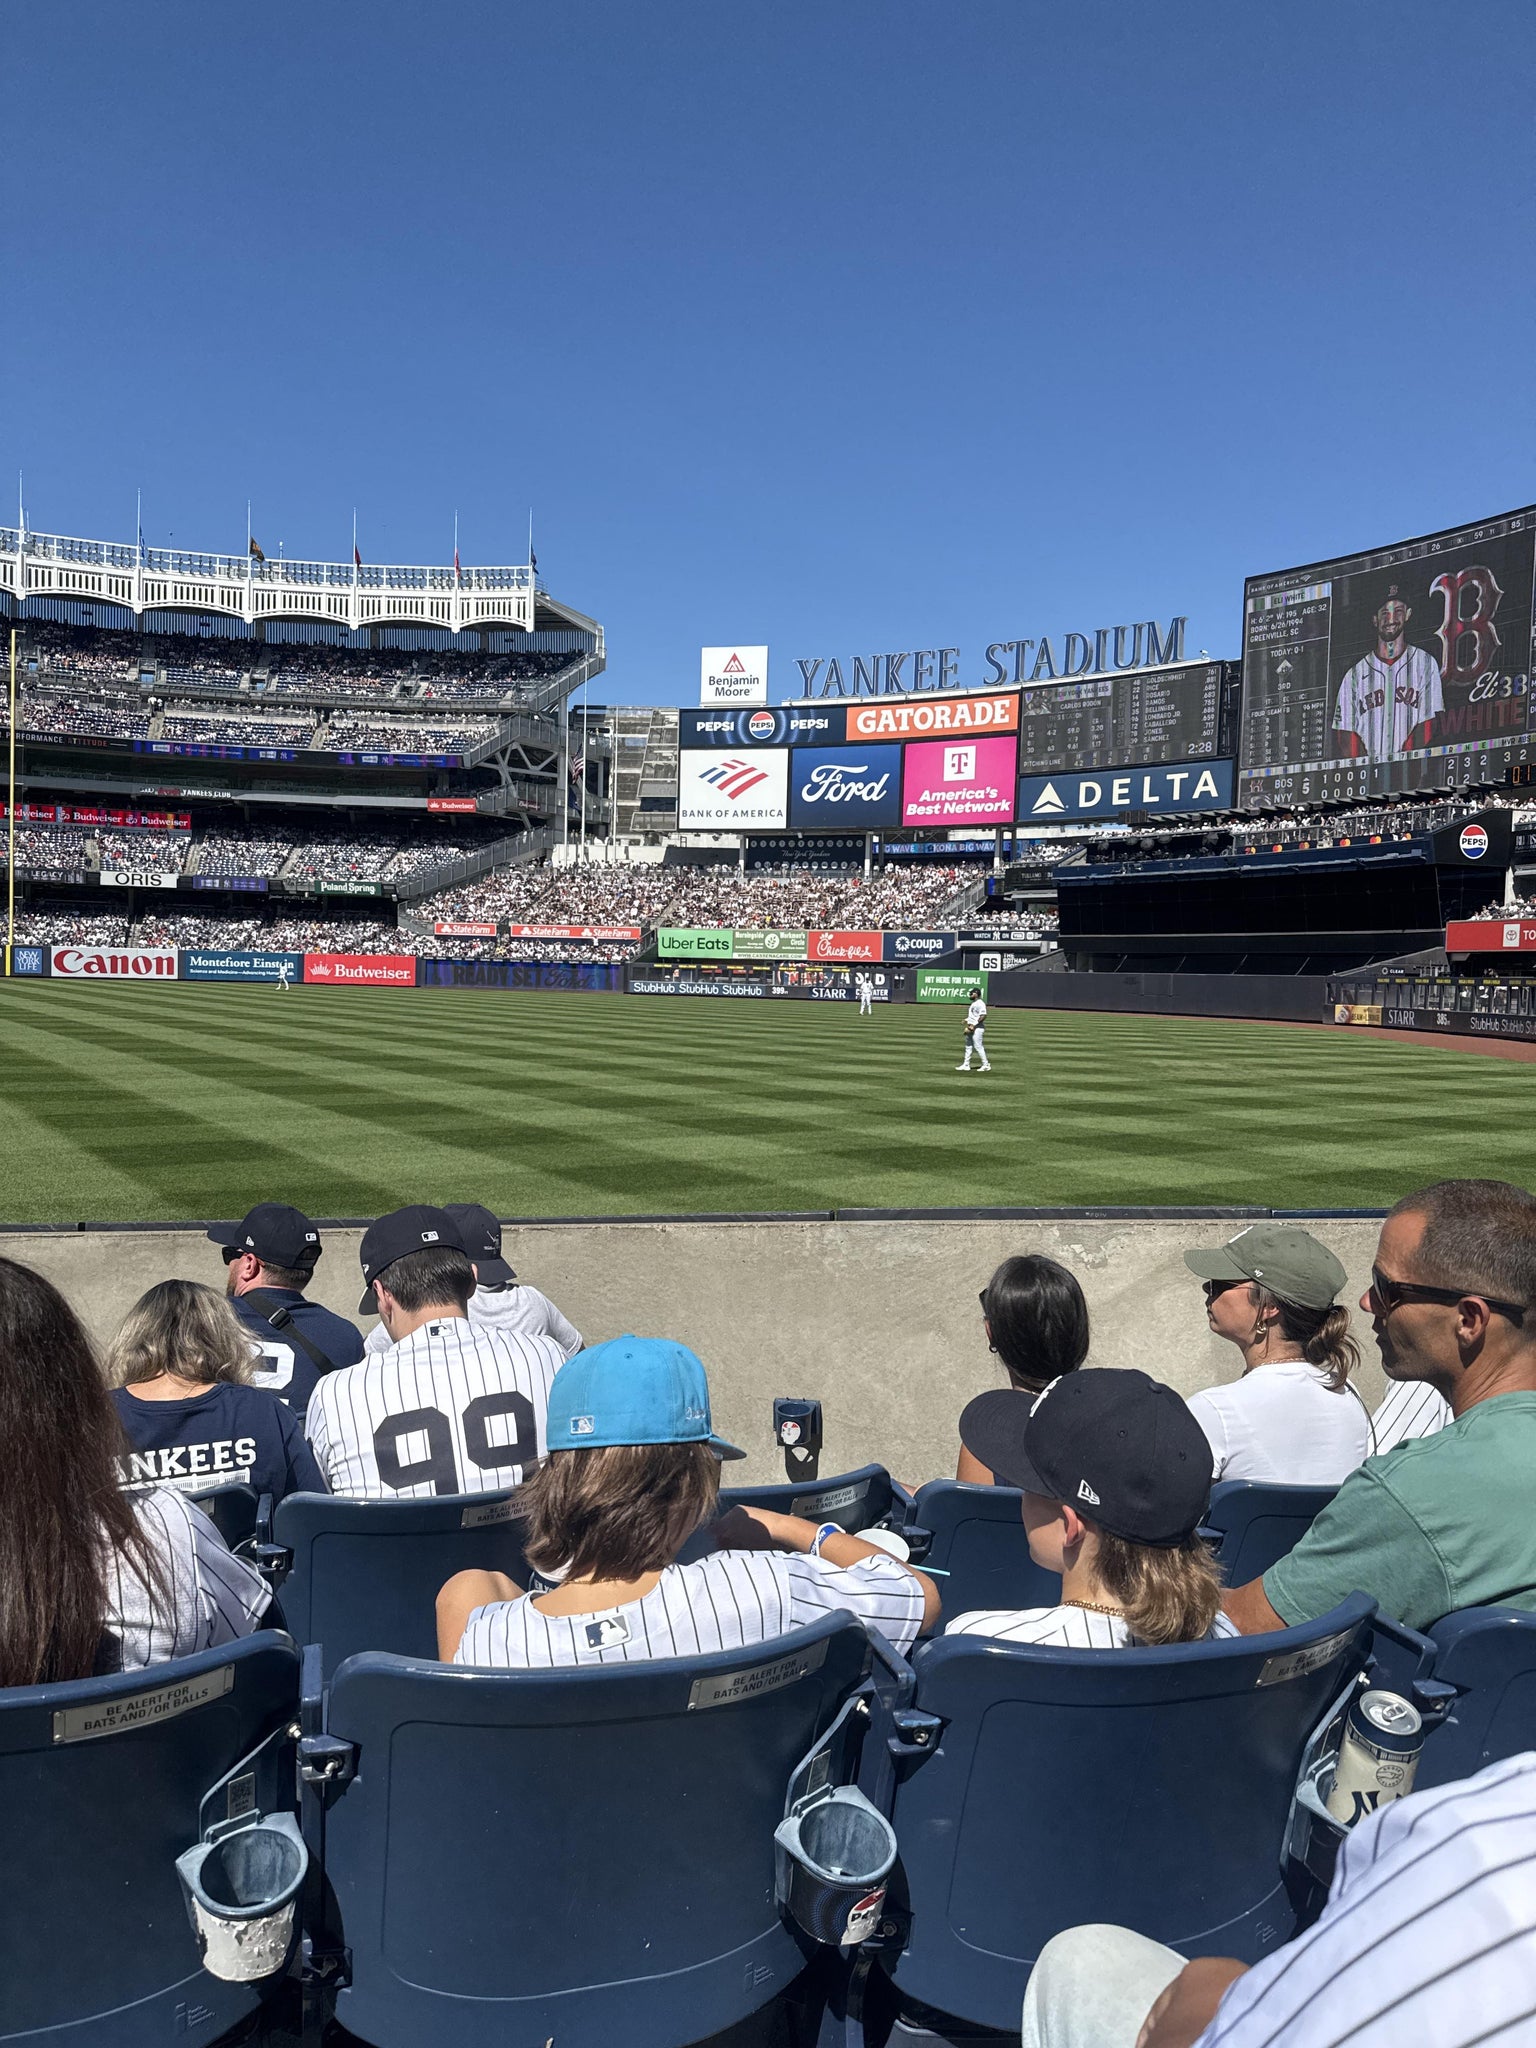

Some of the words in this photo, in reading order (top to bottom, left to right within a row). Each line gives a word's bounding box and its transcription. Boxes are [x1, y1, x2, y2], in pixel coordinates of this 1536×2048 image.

[793, 646, 960, 698] YANKEE
[982, 616, 1188, 685] STADIUM
[708, 675, 760, 687] Benjamin
[1468, 670, 1500, 702] Eli
[1499, 674, 1528, 698] 38
[715, 686, 750, 696] Moore
[856, 699, 1010, 734] GATORADE
[696, 721, 734, 732] PEPSI
[790, 718, 828, 730] PEPSI
[5, 731, 63, 744] PRFORMANCE
[1188, 741, 1212, 754] 2:28
[1274, 778, 1293, 788] BOS
[1302, 782, 1310, 795] 5
[1448, 758, 1455, 770] 2
[1464, 756, 1471, 768] 3
[1480, 754, 1487, 766] 2
[1504, 752, 1511, 762] 3
[1520, 749, 1527, 760] 2
[801, 764, 890, 803] Ford
[1078, 770, 1218, 808] DELTA
[919, 786, 998, 802] America's
[1274, 792, 1292, 804] NYY
[1321, 790, 1328, 799] 0
[1334, 788, 1340, 798] 0
[1346, 787, 1353, 796] 0
[1360, 786, 1366, 795] 0
[442, 802, 474, 810] Budweiser
[682, 809, 712, 818] BANK
[715, 809, 730, 818] OF
[732, 808, 784, 818] AMERICA
[906, 804, 942, 816] Best
[943, 799, 1012, 814] Network
[73, 812, 122, 822] Budweiser
[141, 816, 188, 827] Budweiser
[976, 842, 996, 851] WAV
[1462, 838, 1486, 846] PEPSI
[115, 872, 162, 886] ORIS
[320, 881, 348, 892] Poland
[348, 882, 376, 894] Spring
[662, 936, 694, 950] Uber
[697, 937, 730, 950] Eats
[910, 938, 944, 952] coupa
[16, 957, 40, 965] YORK
[19, 950, 38, 959] NEW
[19, 963, 38, 971] LIFE
[54, 949, 175, 976] Canon
[190, 956, 250, 968] Montefiore
[982, 958, 998, 969] GS
[334, 963, 411, 980] Budweiser
[634, 982, 676, 994] StubHub
[678, 983, 720, 994] StubHub
[722, 984, 762, 996] StubHub
[812, 988, 847, 999] STARR
[1388, 1010, 1415, 1026] STARR
[1470, 1016, 1500, 1032] StubHub
[1501, 1018, 1524, 1034] StubHub
[374, 1390, 538, 1496] 99
[732, 1676, 746, 1687] BE
[749, 1667, 777, 1682] ALERT
[780, 1660, 797, 1671] FOR
[714, 1688, 739, 1700] BATS
[741, 1675, 781, 1693] AND/OR
[782, 1662, 808, 1680] BALLS
[106, 1706, 122, 1716] BE
[126, 1696, 162, 1712] ALERT
[168, 1686, 189, 1698] FOR
[84, 1716, 116, 1730] BATS
[119, 1700, 170, 1724] AND/OR
[173, 1688, 209, 1708] BALLS
